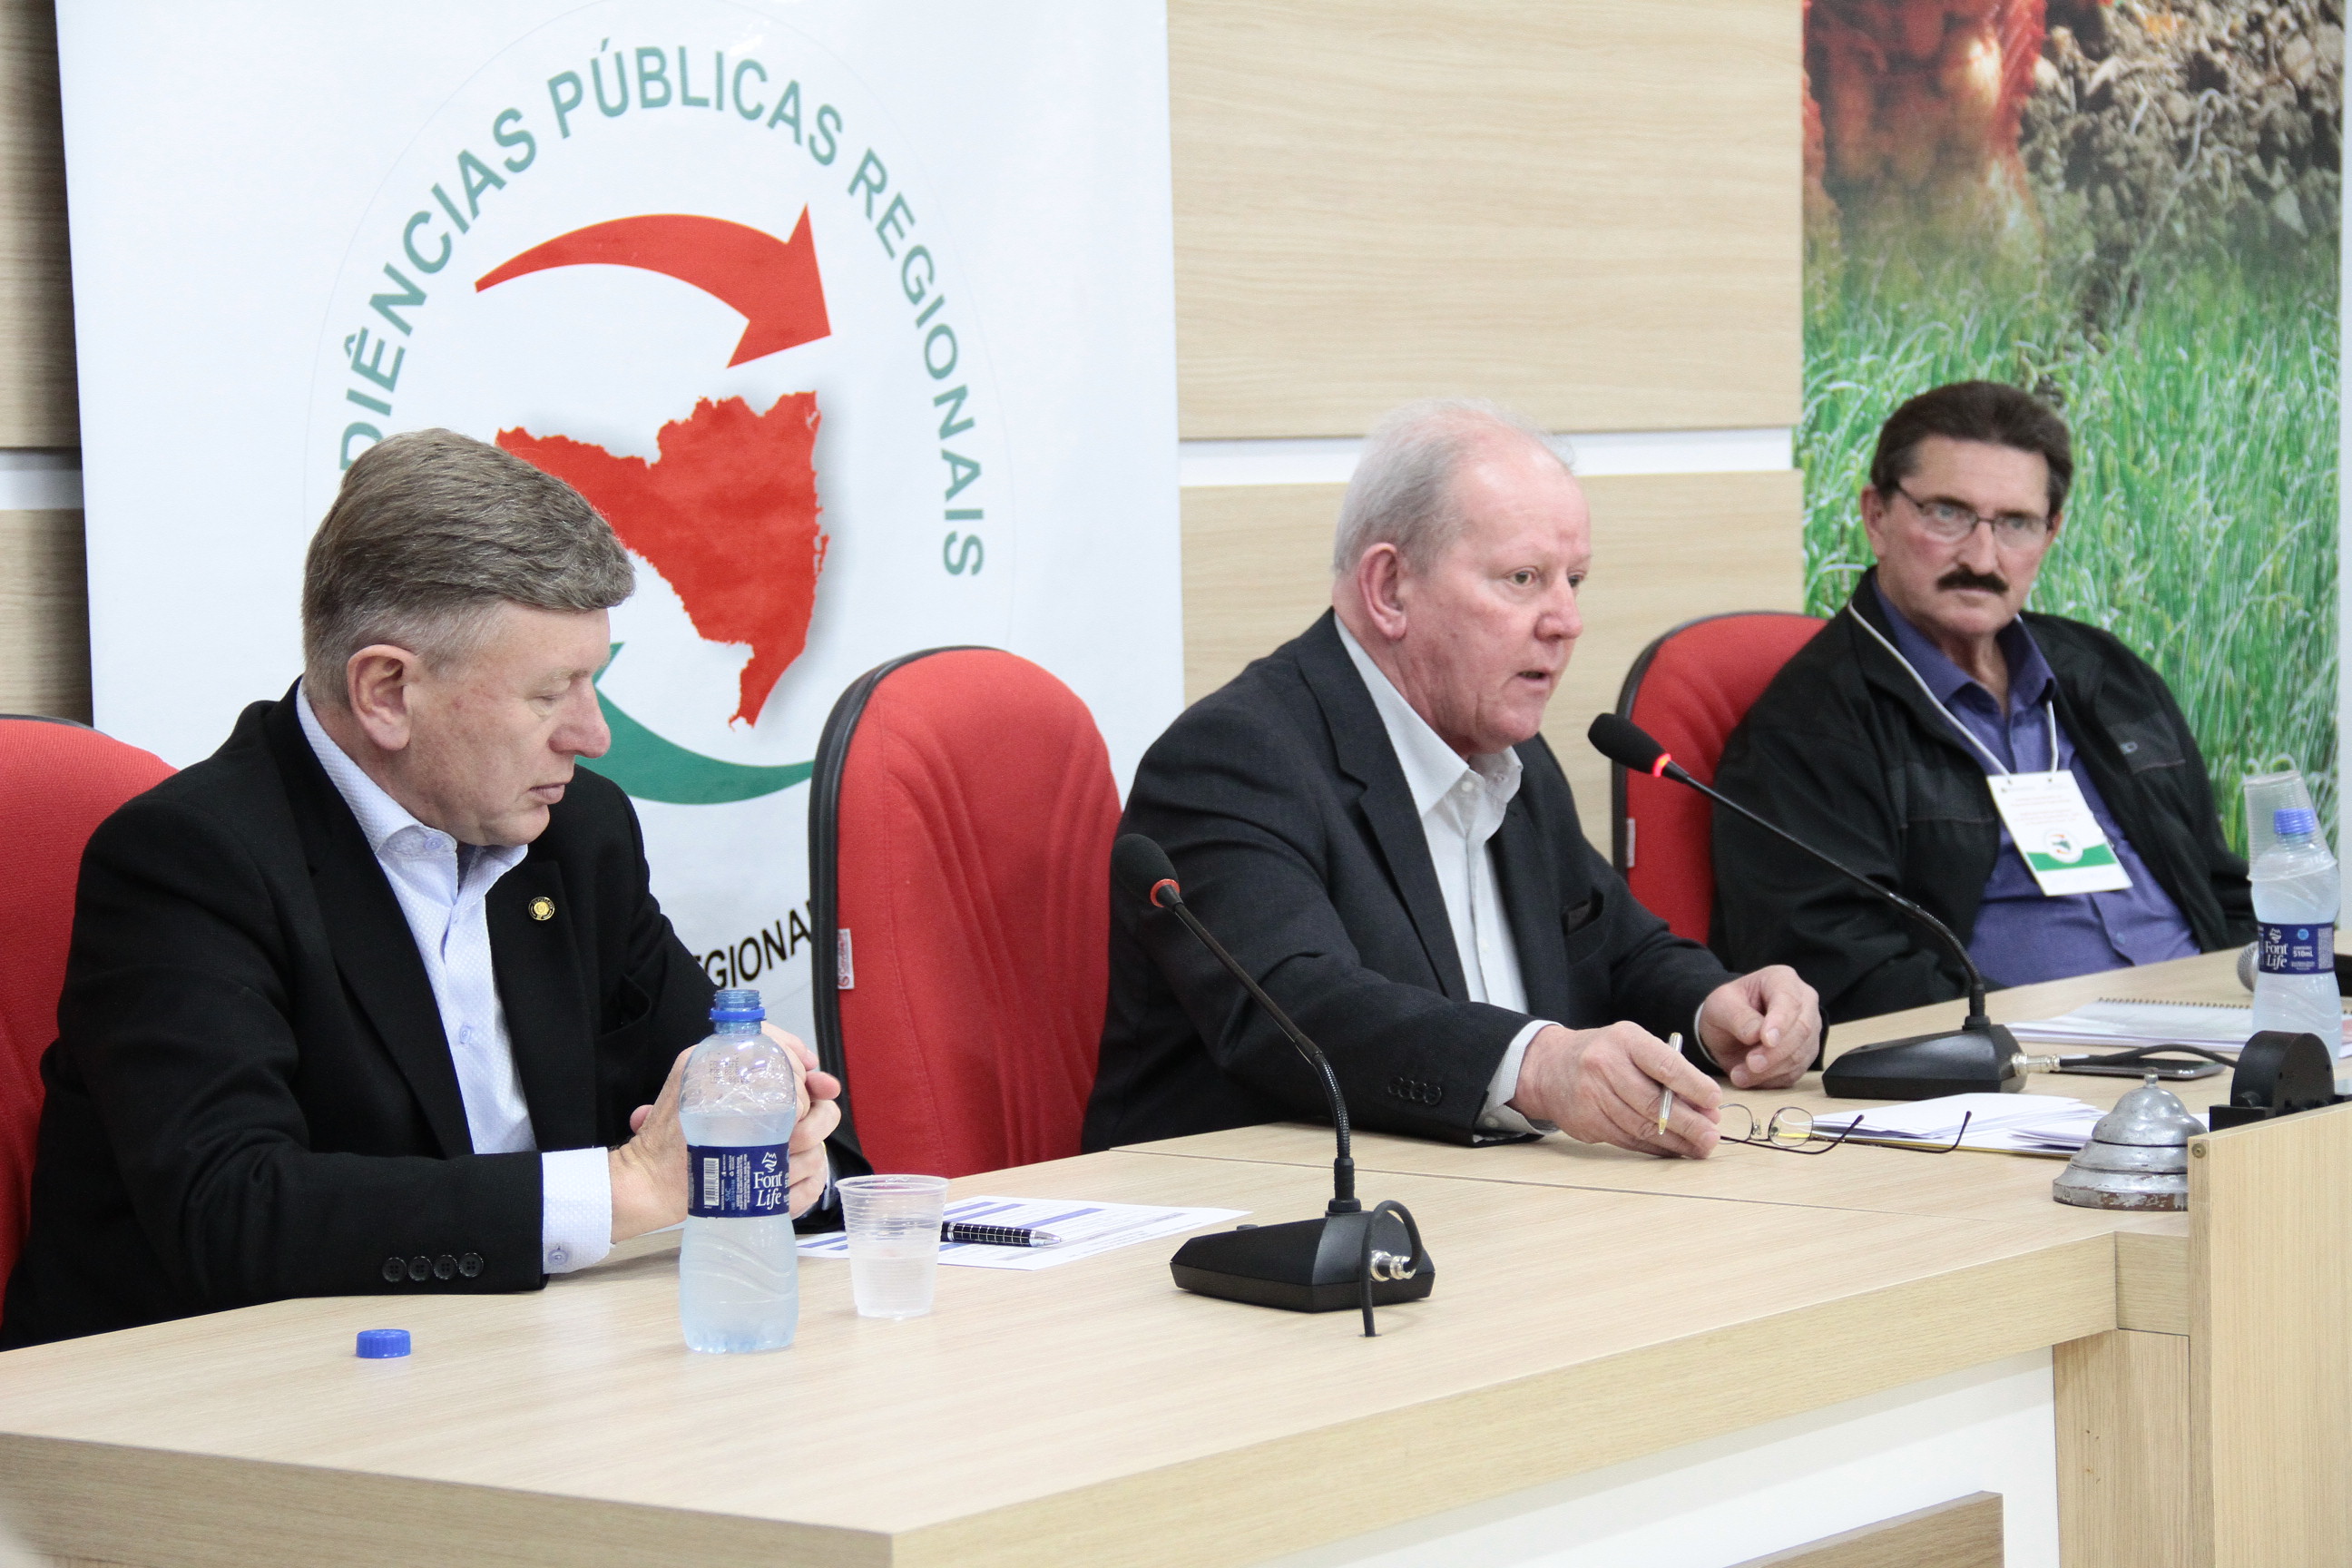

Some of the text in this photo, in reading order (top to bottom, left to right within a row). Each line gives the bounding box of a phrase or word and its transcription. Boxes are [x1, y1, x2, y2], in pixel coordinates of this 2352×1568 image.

[546, 37, 844, 167] PÚBLICAS
[847, 147, 985, 578] REGIONAIS
[692, 899, 811, 988] GIONA
[2265, 941, 2288, 956] Font
[2267, 955, 2288, 971] Life
[752, 1171, 784, 1190] Font
[756, 1189, 782, 1210] Life
